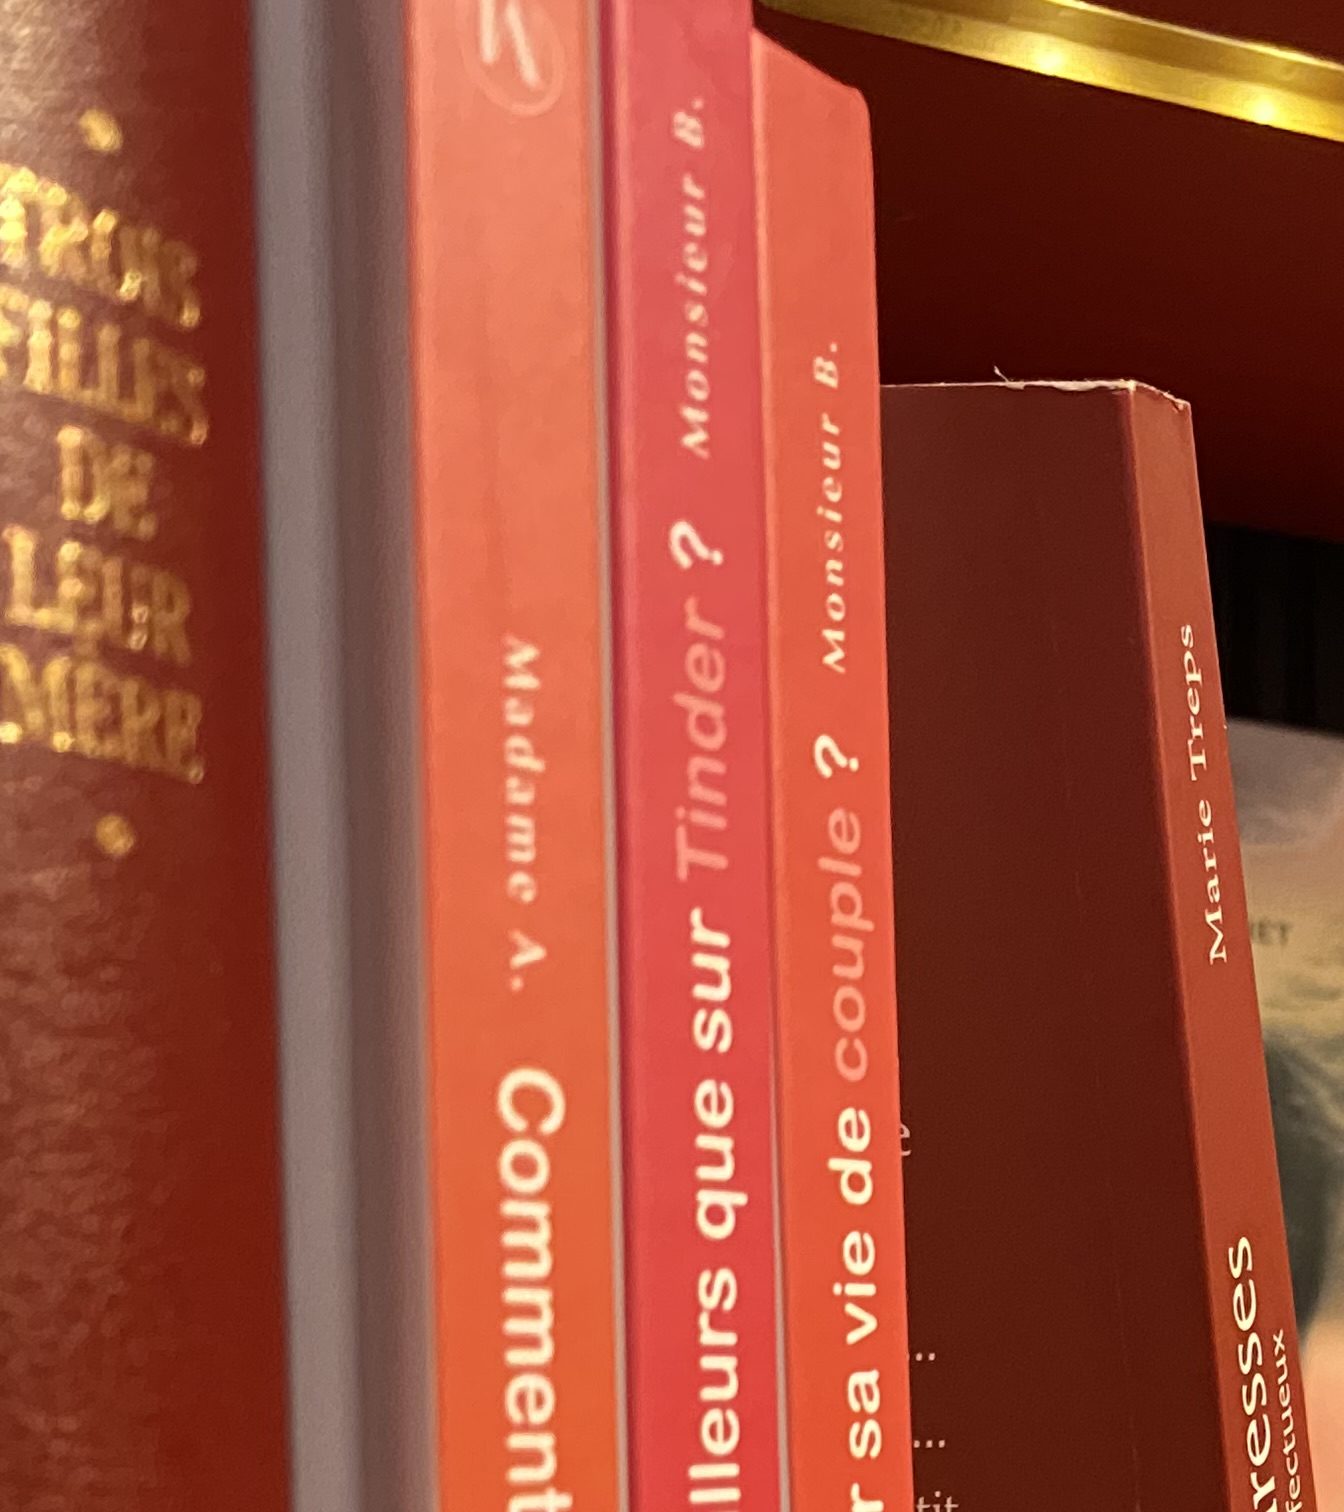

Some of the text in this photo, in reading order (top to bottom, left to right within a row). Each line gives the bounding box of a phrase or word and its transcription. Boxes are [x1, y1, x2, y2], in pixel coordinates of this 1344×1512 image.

[671, 97, 712, 460] Monsieur B.
[57, 425, 157, 542] DE
[668, 520, 724, 570] ?
[812, 341, 846, 675] Monsieur B.
[2, 524, 192, 668] LEUR
[502, 633, 548, 994] Madame A.
[673, 596, 730, 882] Tinder
[813, 733, 860, 779] ?
[1180, 623, 1228, 966] Marie Treps
[689, 906, 734, 1055] sur
[817, 806, 876, 1083] couple
[694, 1078, 749, 1241] que
[826, 1104, 874, 1207] de
[831, 1228, 880, 1346] vie
[846, 1367, 883, 1461] sa
